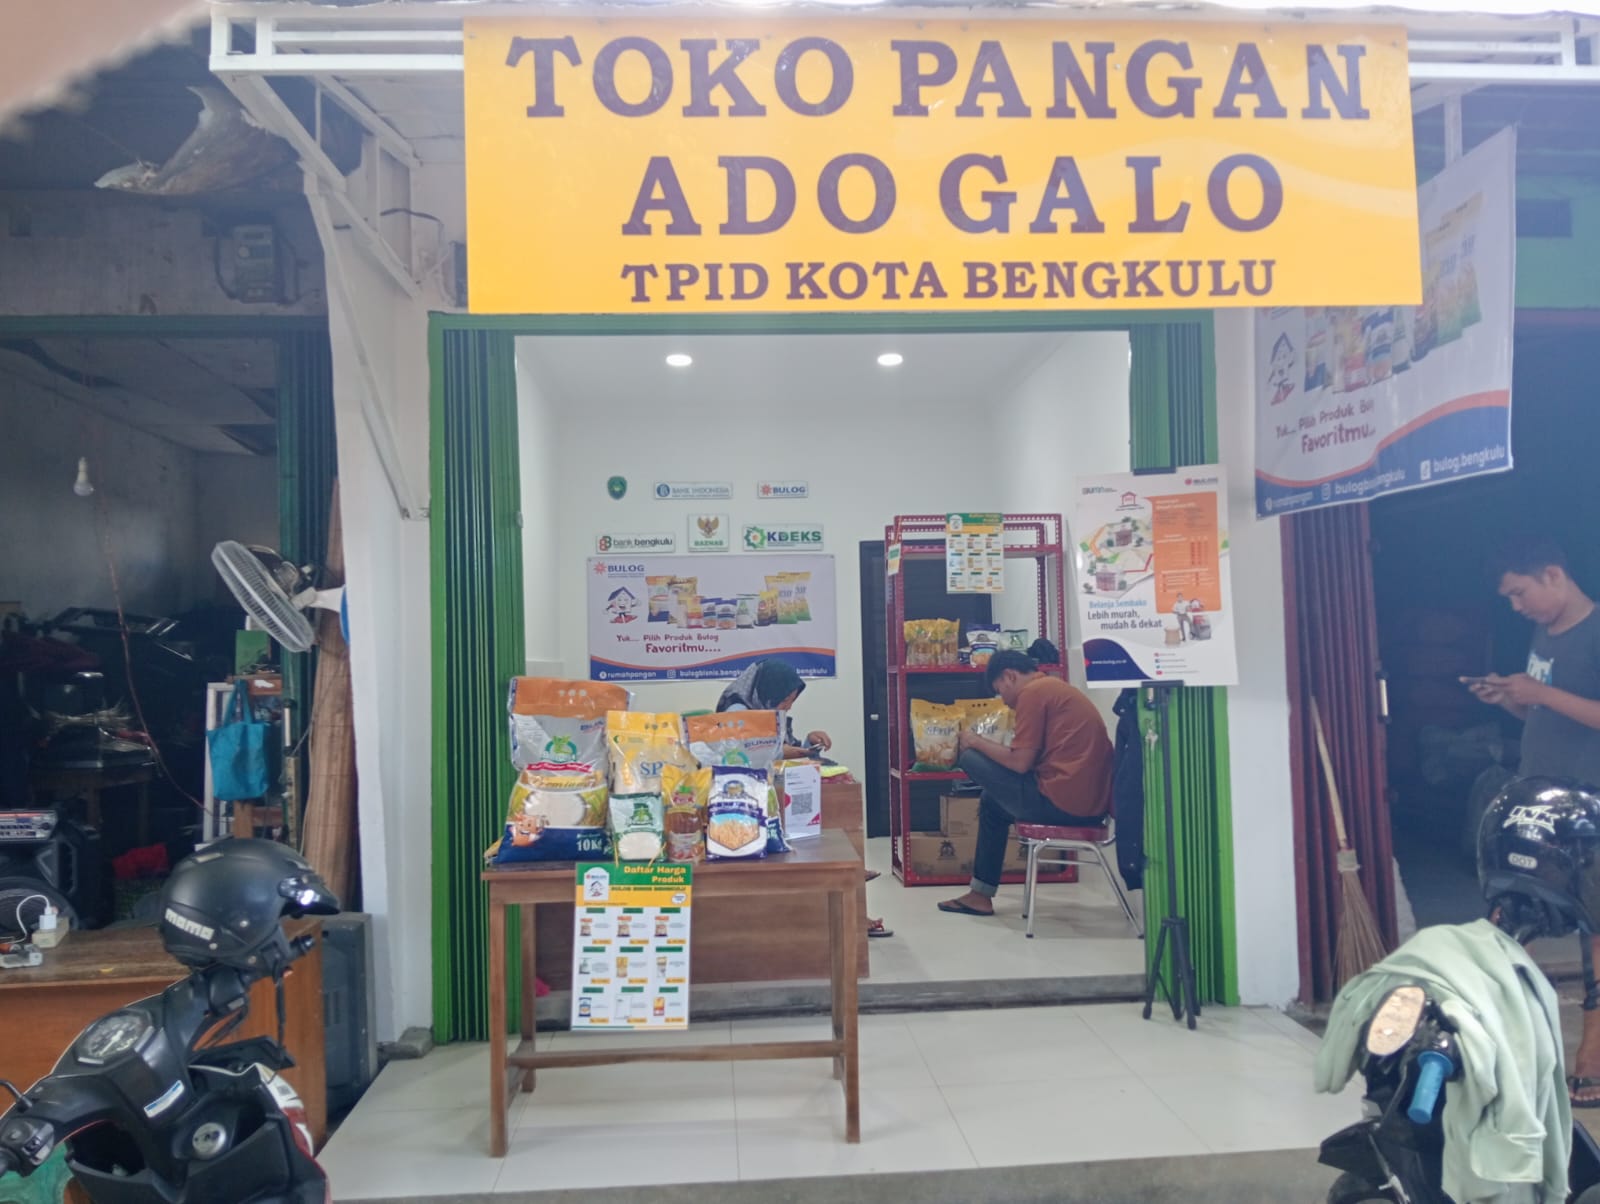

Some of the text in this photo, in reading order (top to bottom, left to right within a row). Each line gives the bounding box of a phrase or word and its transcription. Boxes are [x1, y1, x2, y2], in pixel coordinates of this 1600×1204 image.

[505, 35, 1370, 121] TOKO PANGAN
[620, 152, 1284, 236] ADO GALO
[620, 257, 1277, 302] TPID KOTA BENGKULU
[1319, 406, 1354, 425] Produk
[1433, 444, 1505, 473] bulog.bengkulu
[773, 486, 806, 494] BULOG
[767, 530, 822, 542] KDEKS
[634, 537, 673, 547] bengkulu
[607, 564, 645, 573] BULOG
[1088, 609, 1140, 620] Lebih murah,
[1100, 619, 1162, 630] mudah & dekat
[643, 633, 661, 641] Pilih
[664, 634, 692, 642] Produk
[796, 668, 828, 676] bengkulu
[1510, 855, 1535, 867] DOT
[624, 865, 687, 876] Daftar Harga
[652, 875, 685, 883] Produk
